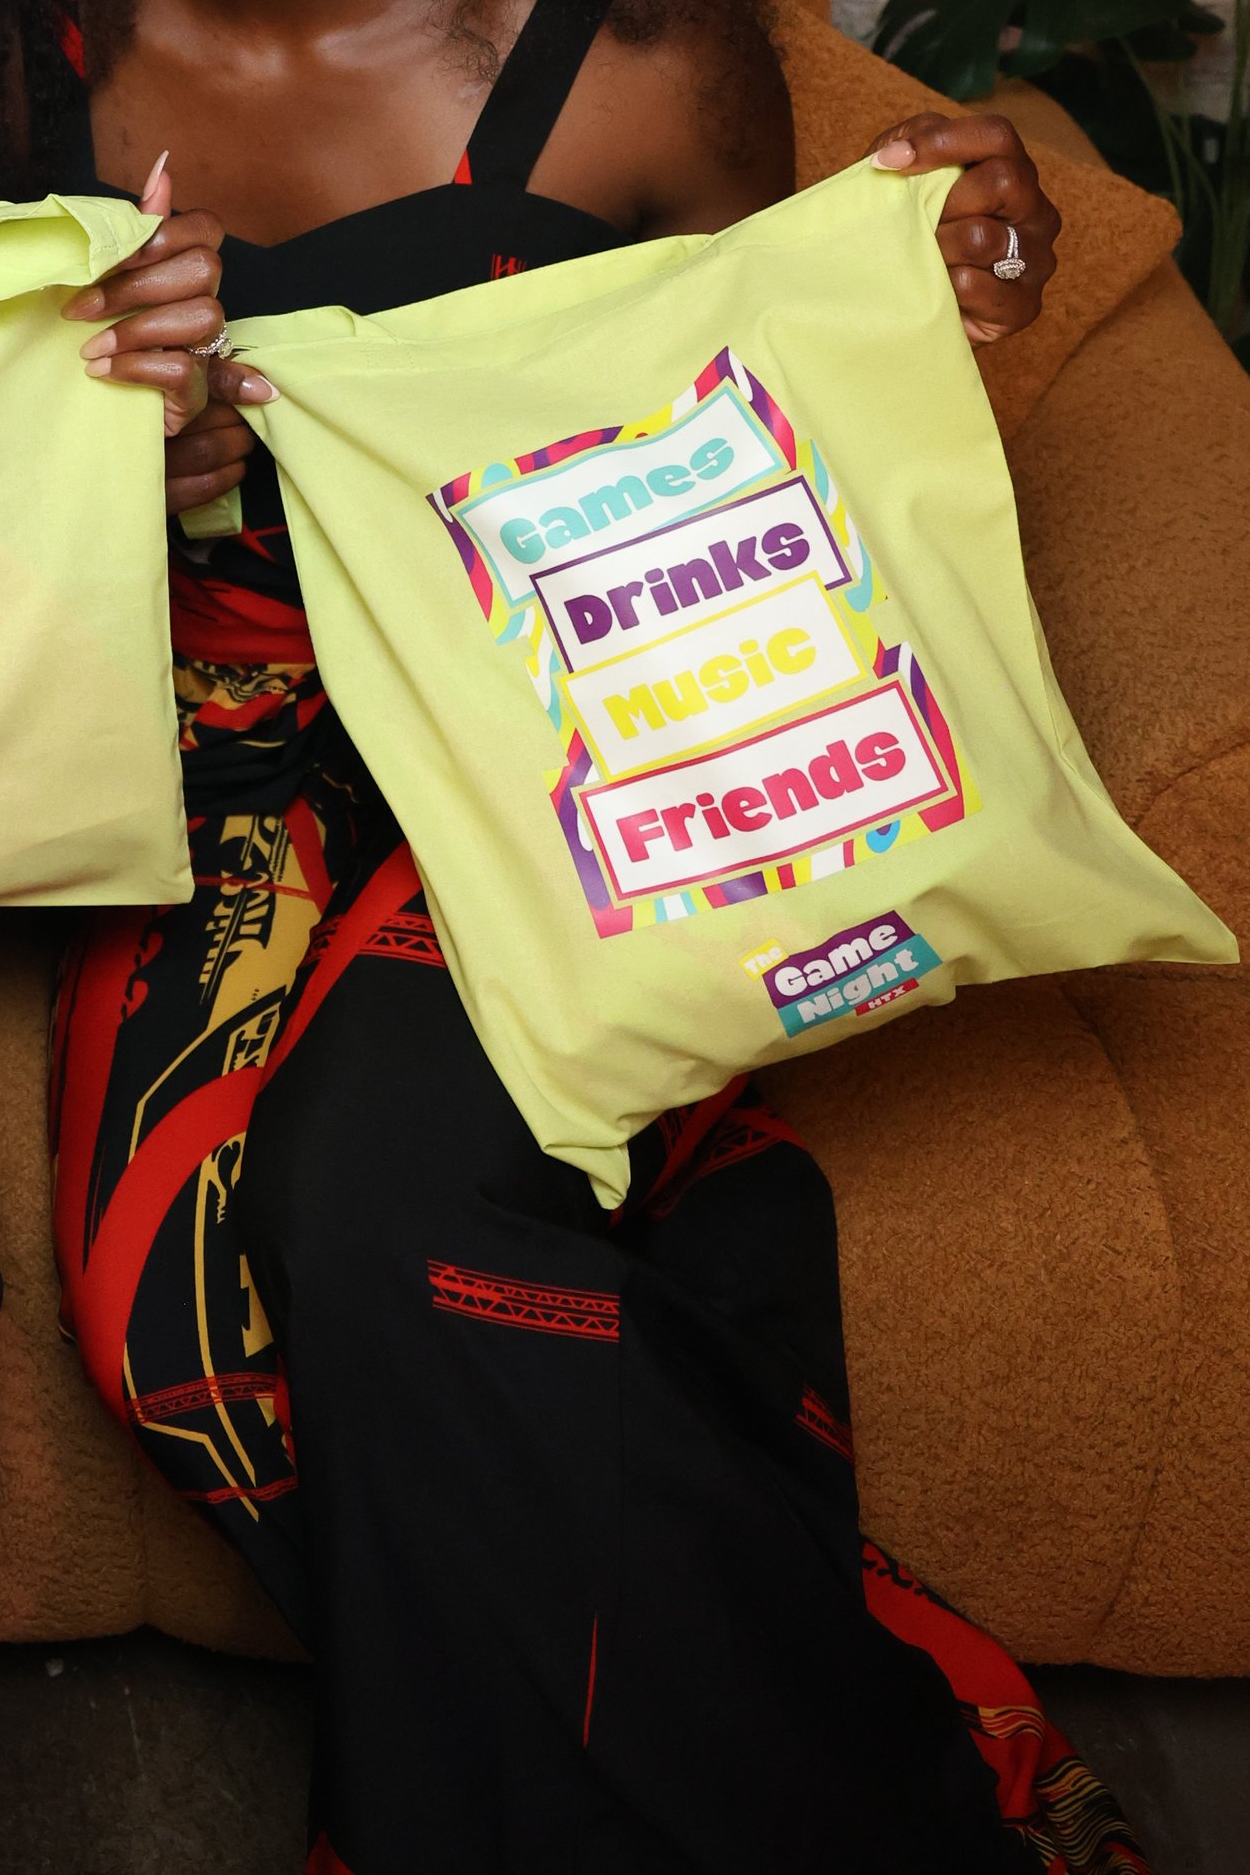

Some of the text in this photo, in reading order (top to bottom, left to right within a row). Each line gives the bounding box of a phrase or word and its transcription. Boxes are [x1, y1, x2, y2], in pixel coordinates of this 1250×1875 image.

[498, 437, 735, 564] Games
[564, 522, 811, 645] Drinks
[601, 627, 816, 740] Music
[615, 731, 906, 863] Friends
[744, 946, 783, 974] The
[774, 925, 898, 996] Game
[797, 948, 918, 1024] Night
[867, 985, 906, 1009] HTX
